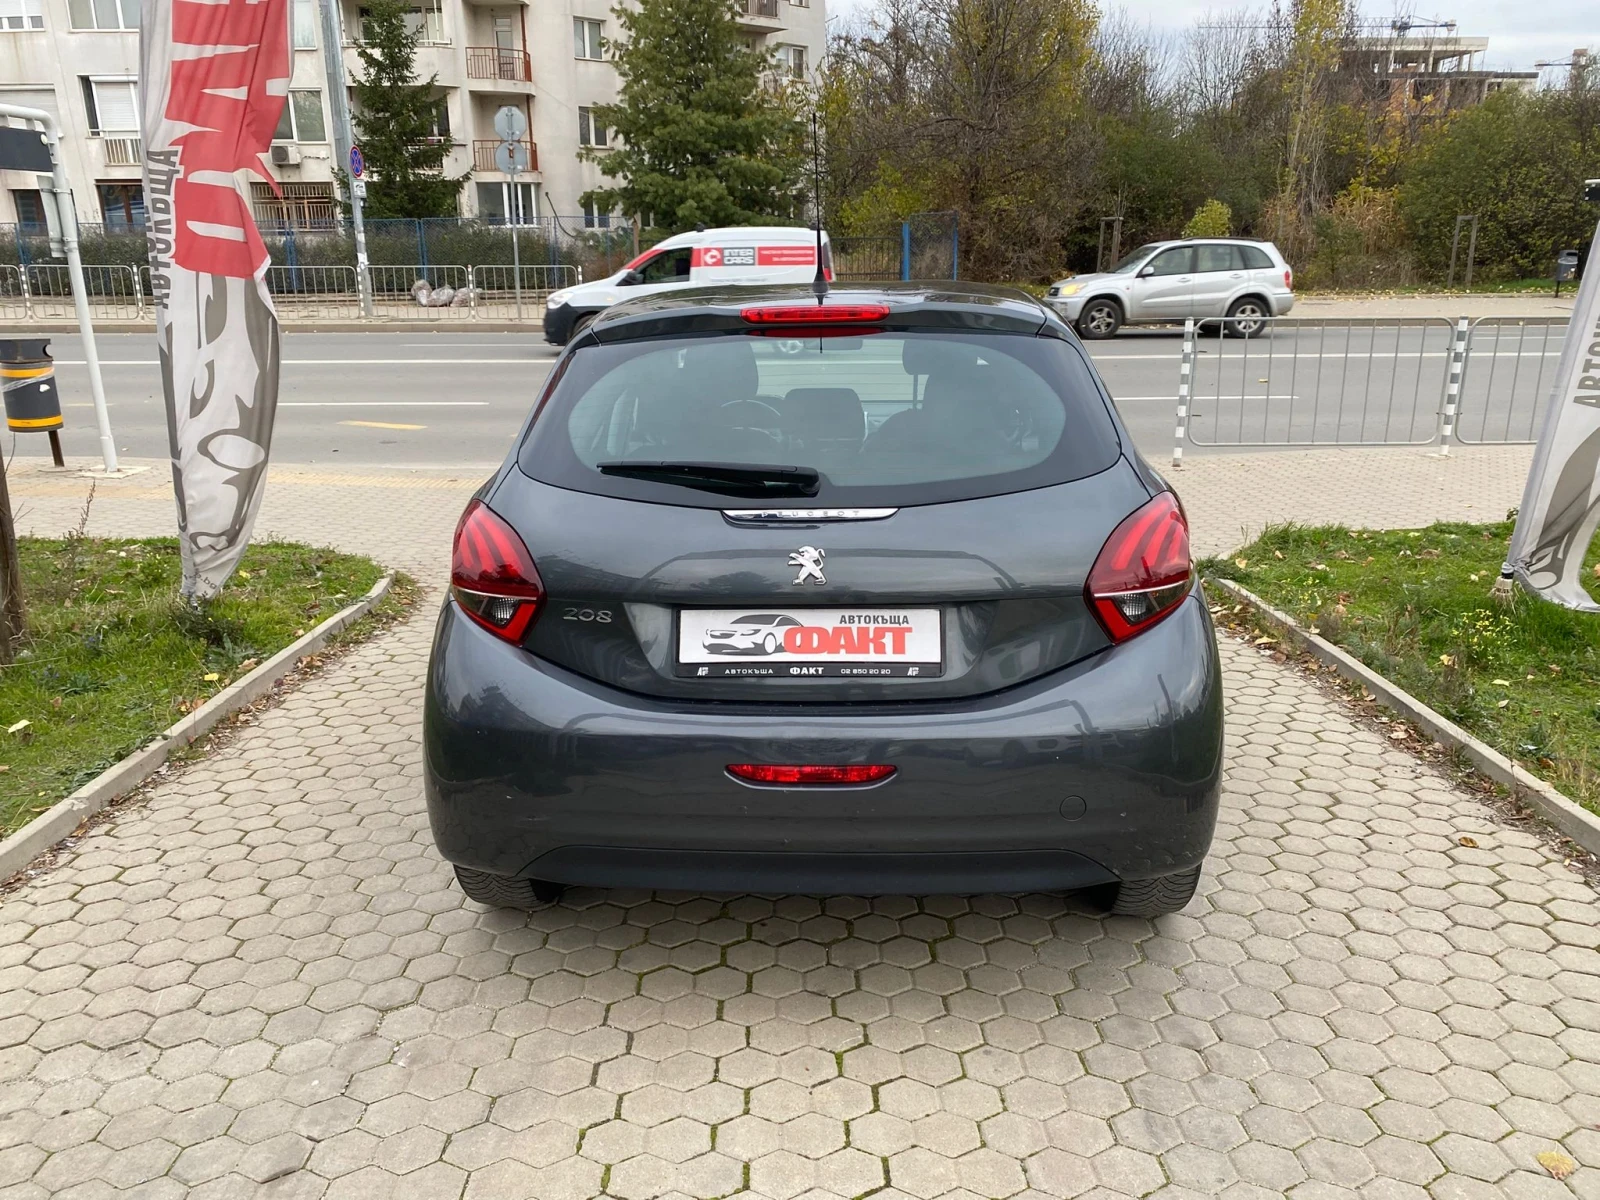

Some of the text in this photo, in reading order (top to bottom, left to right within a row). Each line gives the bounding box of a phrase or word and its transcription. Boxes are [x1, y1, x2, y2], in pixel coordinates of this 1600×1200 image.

[723, 248, 754, 257] INTER
[723, 256, 754, 265] CARS
[761, 510, 860, 518] PEUGEOT
[562, 607, 613, 623] 208
[839, 615, 909, 626] АВТОКЪЩА
[783, 626, 913, 655] ФАКТ
[789, 667, 825, 675] ФАКТ
